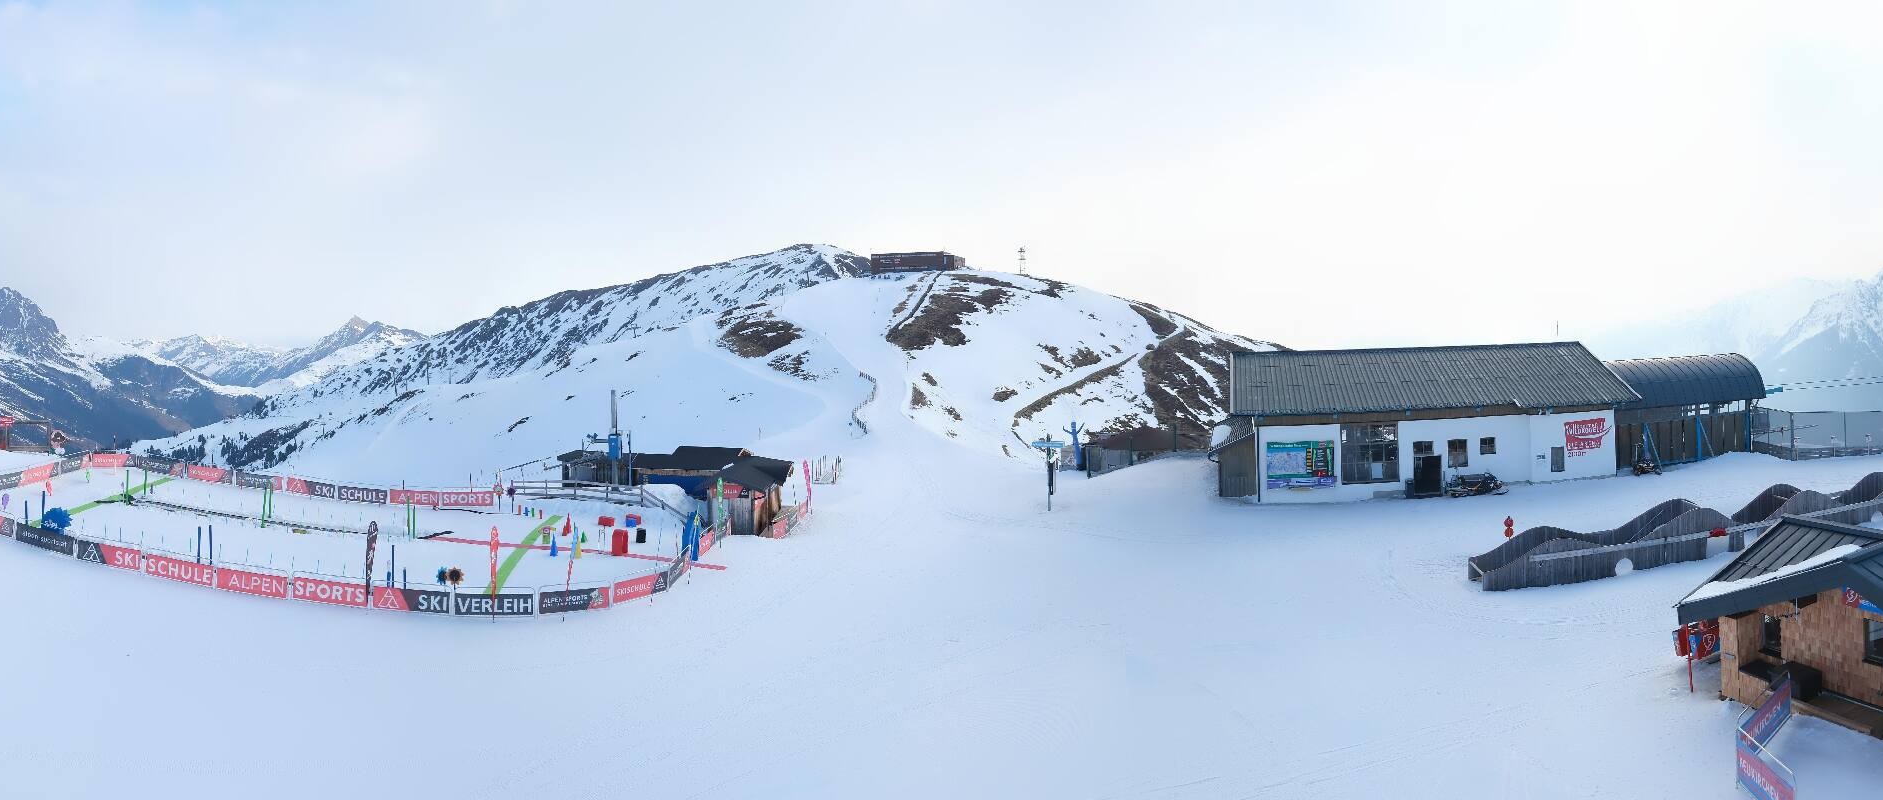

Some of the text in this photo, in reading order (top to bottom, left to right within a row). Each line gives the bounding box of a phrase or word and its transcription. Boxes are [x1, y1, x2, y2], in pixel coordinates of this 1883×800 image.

[315, 485, 491, 504] SKI SCHULE ALPEN SPORTS
[115, 551, 365, 603] SKI SCHULE ALPEN SPORTS
[617, 581, 651, 596] SKISCHULE
[418, 594, 447, 611] SKI
[458, 597, 532, 613] VERLEIH
